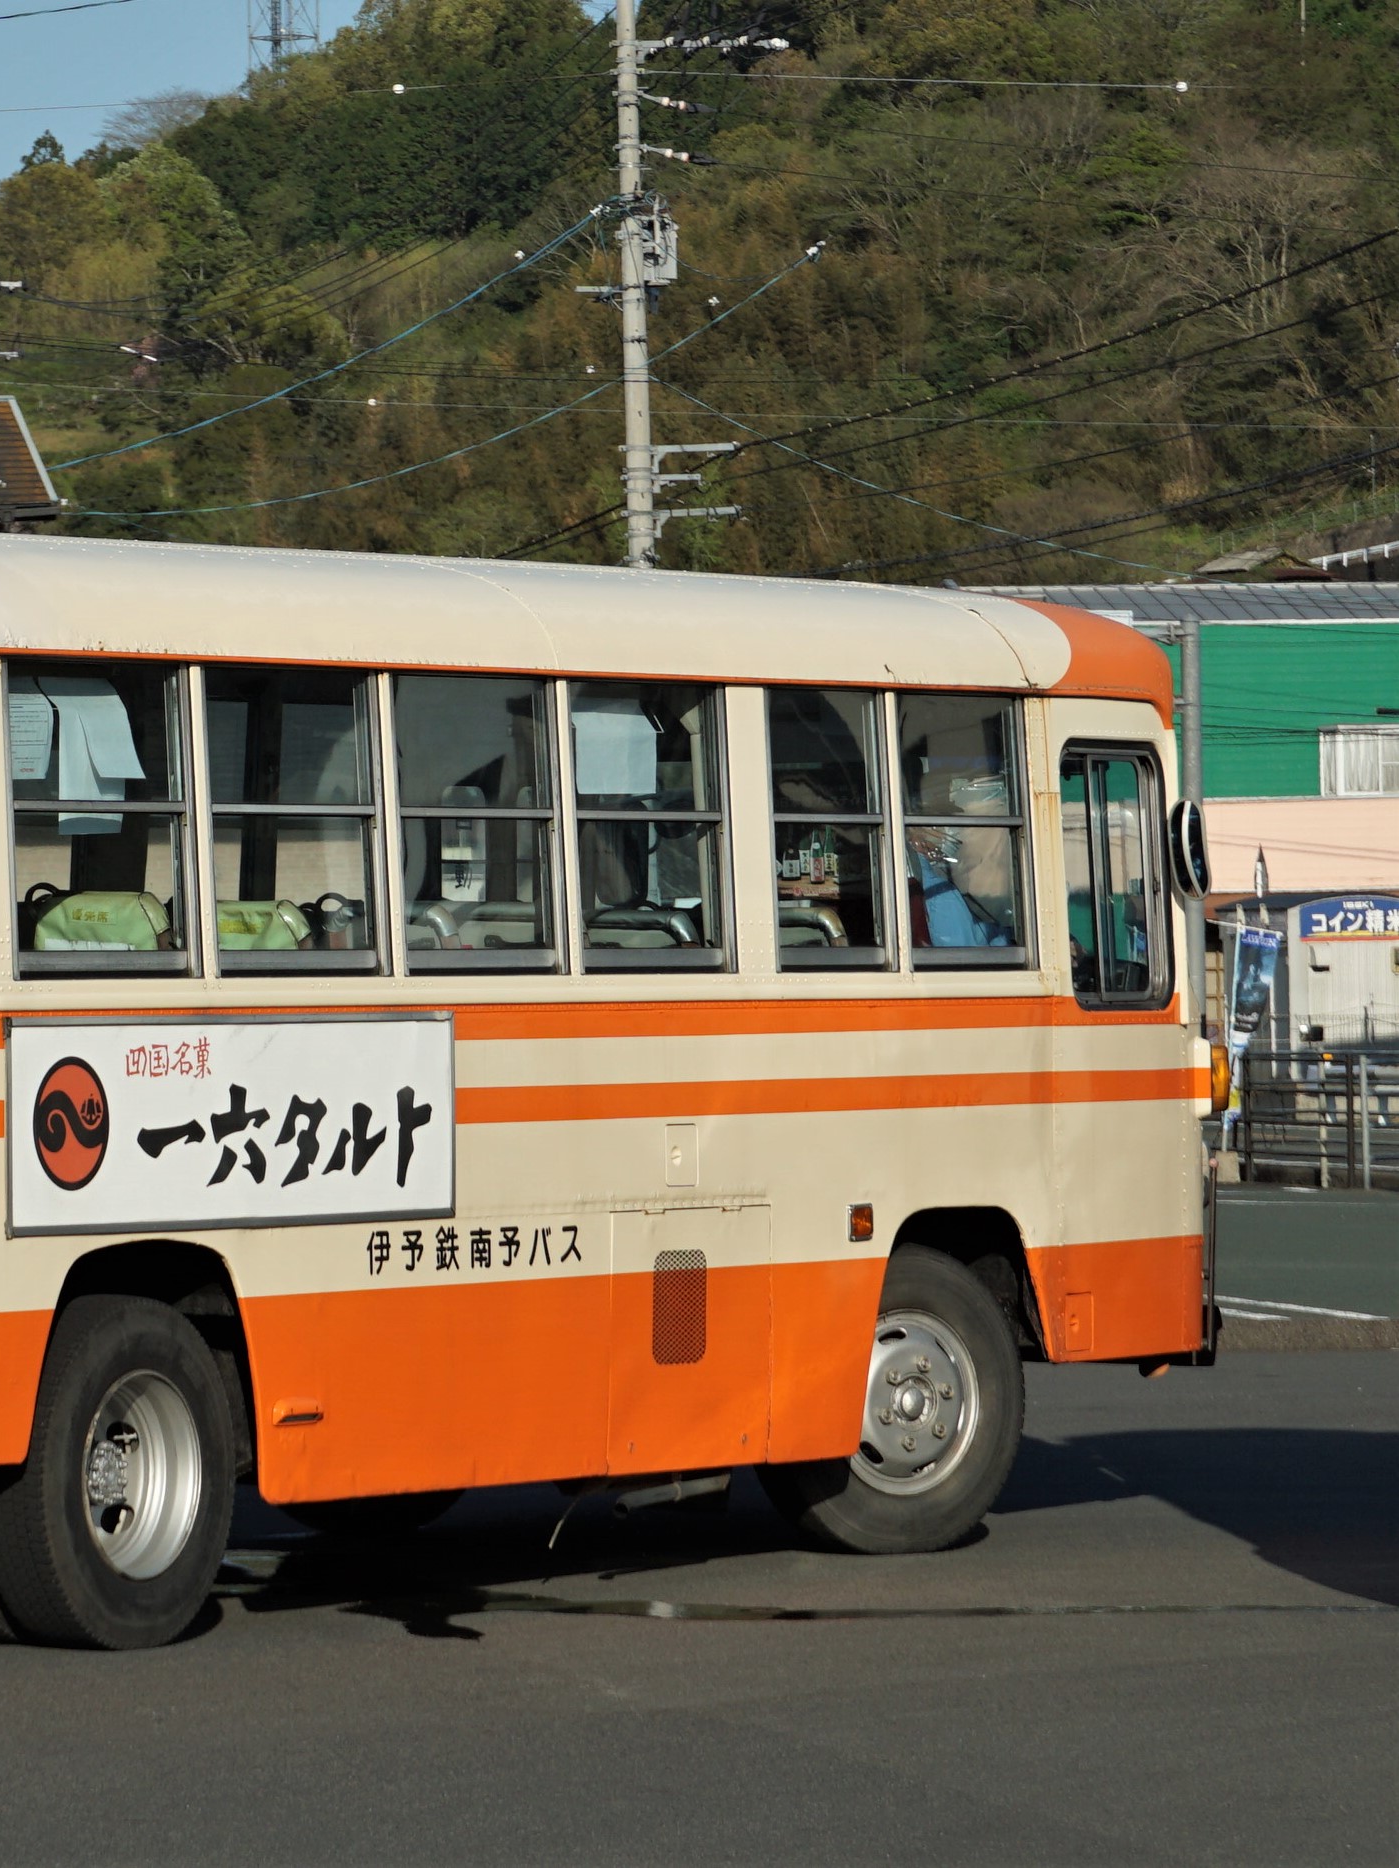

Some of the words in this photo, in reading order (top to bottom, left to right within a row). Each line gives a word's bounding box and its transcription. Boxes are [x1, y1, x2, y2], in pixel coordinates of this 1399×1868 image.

[125, 1036, 212, 1079] 四国名菓
[137, 1083, 432, 1188] 一六タルト
[366, 1225, 582, 1276] 伊予鉄南予バス
